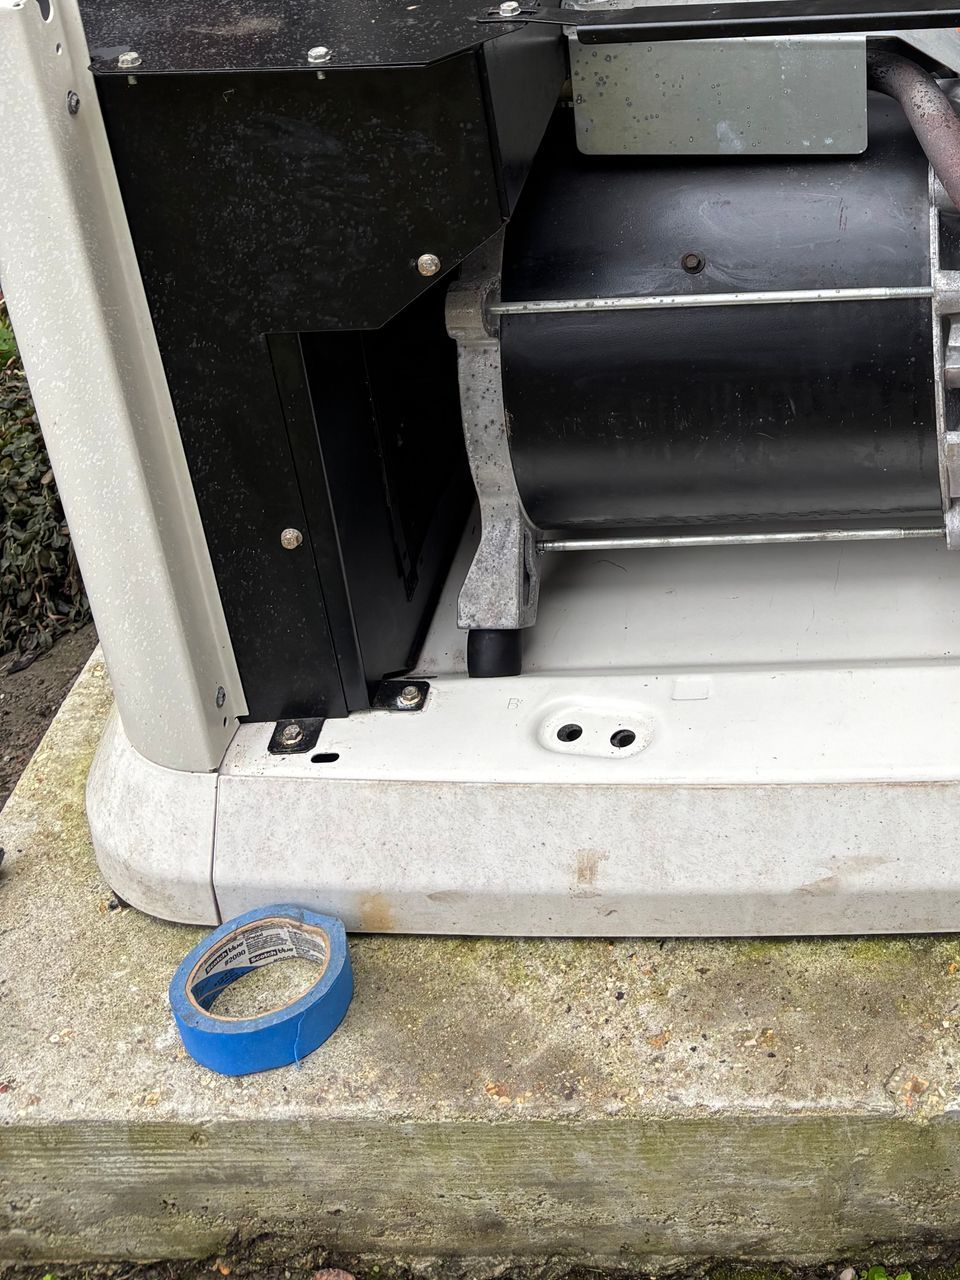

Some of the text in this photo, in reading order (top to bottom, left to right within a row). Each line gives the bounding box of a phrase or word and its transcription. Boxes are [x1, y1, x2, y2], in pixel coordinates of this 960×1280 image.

[206, 951, 228, 973] Scotch
[225, 949, 246, 966] #2090
[250, 950, 277, 963] Scotch
